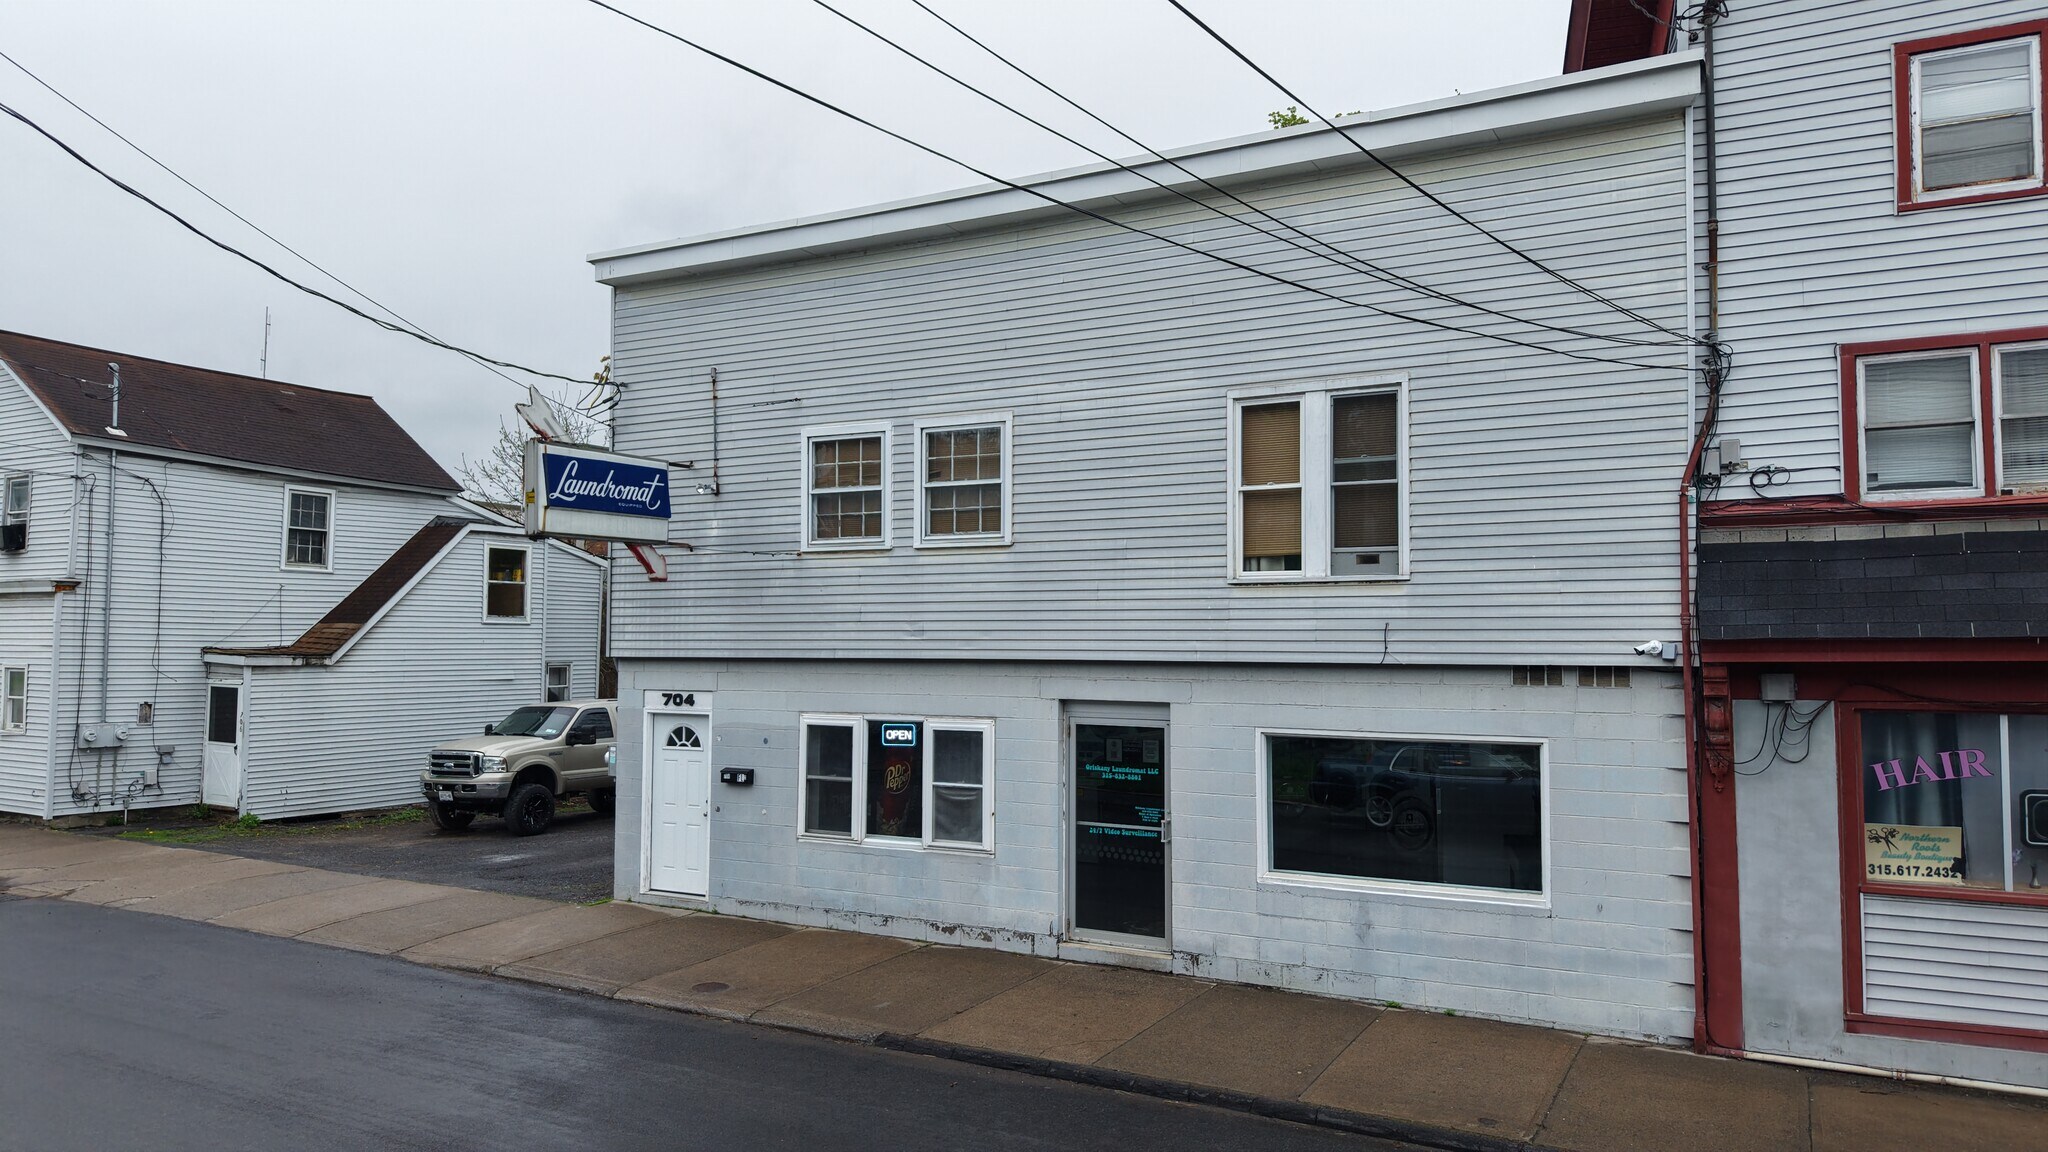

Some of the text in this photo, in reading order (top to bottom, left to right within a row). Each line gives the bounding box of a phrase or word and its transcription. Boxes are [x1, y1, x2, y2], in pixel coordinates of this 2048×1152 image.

[549, 459, 665, 510] Laundromat
[662, 693, 695, 707] 704
[886, 730, 912, 740] OPEN
[895, 764, 906, 777] Dr
[1112, 766, 1146, 774] Laundromat
[1870, 749, 1994, 791] HAIR
[886, 766, 911, 790] Pepper
[1104, 827, 1120, 836] Video
[1121, 829, 1158, 837] Surveillance
[1899, 832, 1951, 843] Northern
[1911, 842, 1941, 852] Roots
[1881, 850, 1912, 862] Beauty
